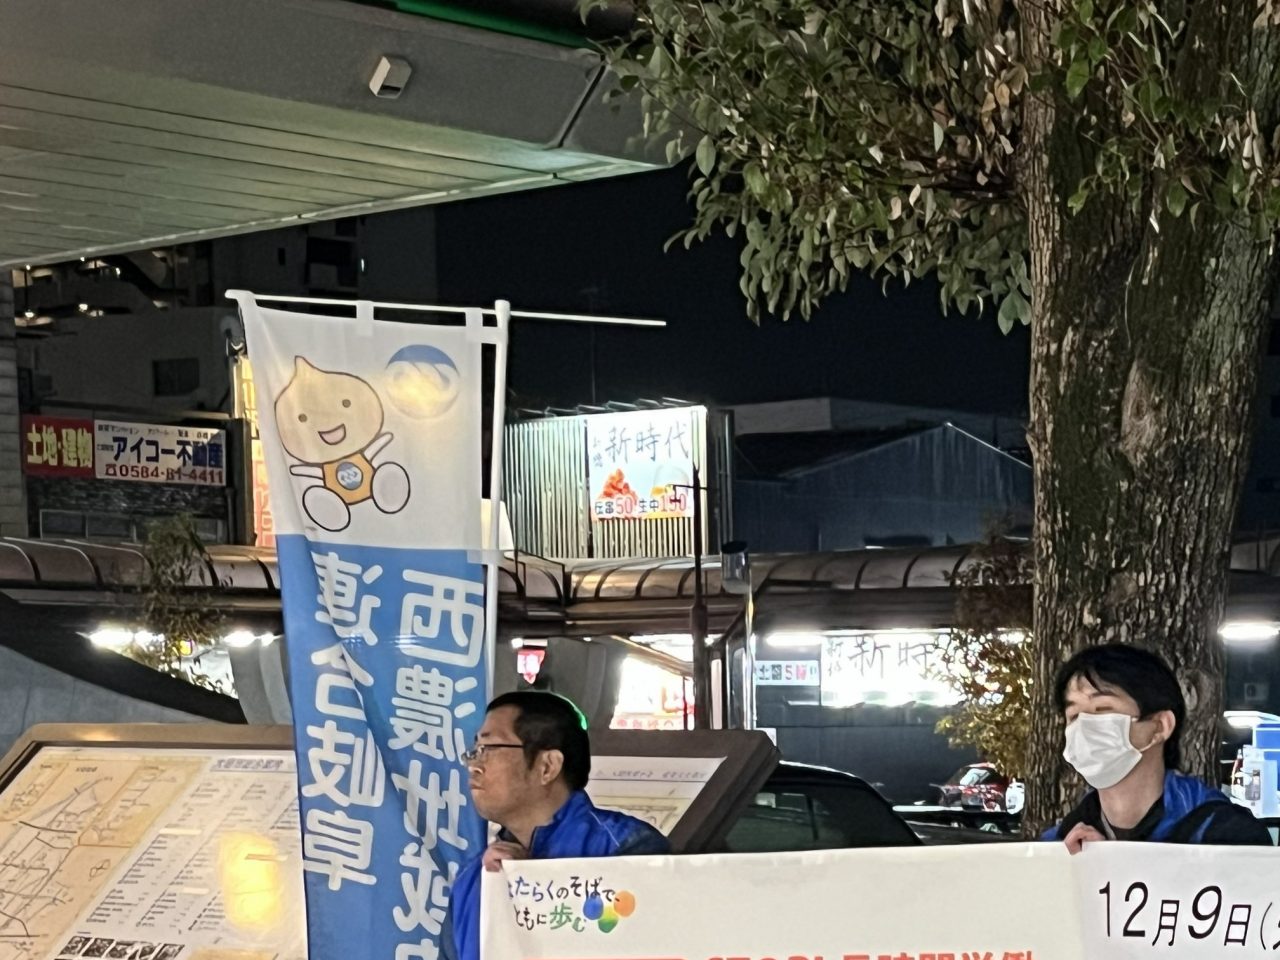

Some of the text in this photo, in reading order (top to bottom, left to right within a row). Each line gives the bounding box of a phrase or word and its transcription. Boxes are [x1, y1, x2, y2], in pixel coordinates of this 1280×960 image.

[605, 420, 690, 464] 新時代
[514, 903, 587, 932] ともに歩む
